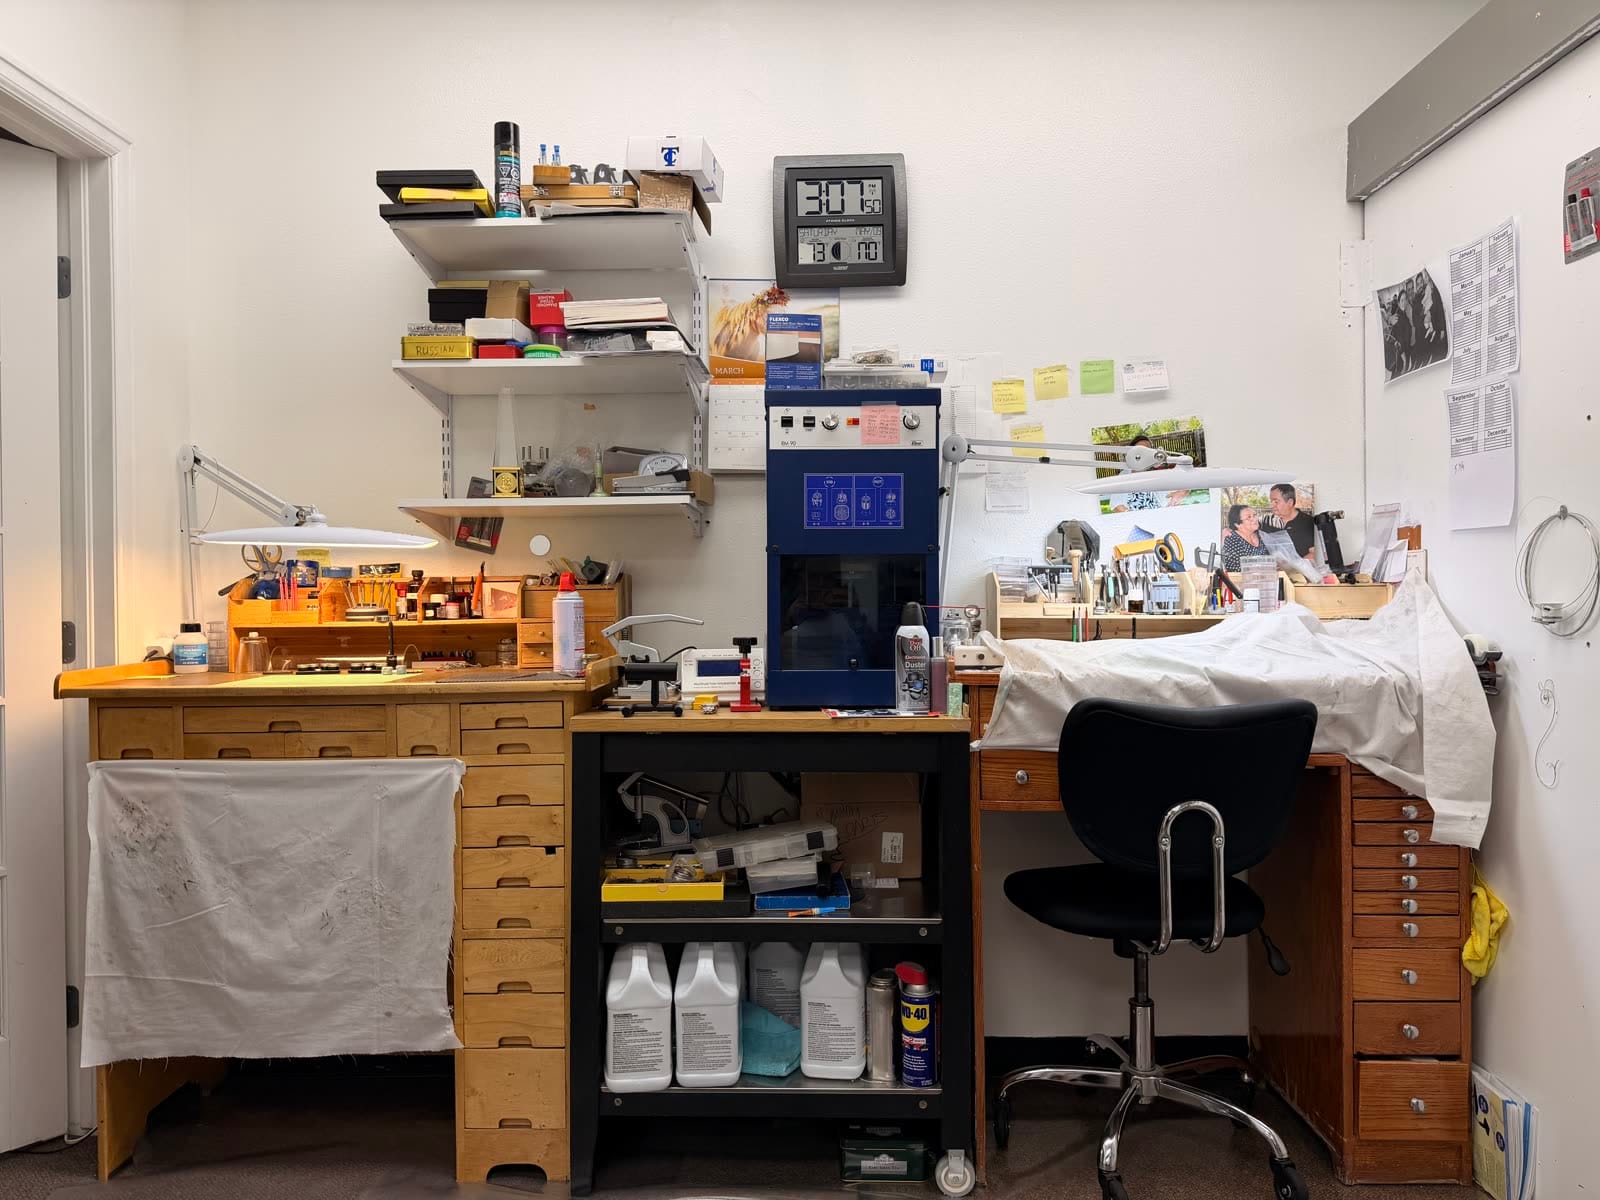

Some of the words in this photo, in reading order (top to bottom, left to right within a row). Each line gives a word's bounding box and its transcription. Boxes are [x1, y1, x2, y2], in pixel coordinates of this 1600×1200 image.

[805, 180, 865, 216] 3:07
[864, 199, 881, 214] 50
[1492, 229, 1510, 242] February
[1457, 248, 1477, 260] January
[1496, 264, 1507, 274] April
[1460, 280, 1474, 290] March
[1495, 294, 1507, 303] June
[1463, 309, 1473, 317] May
[1494, 332, 1510, 343] August
[415, 344, 456, 357] RUSSIAN
[1462, 346, 1473, 354] July
[714, 367, 745, 375] MARCH
[1490, 383, 1507, 393] October
[1451, 392, 1477, 402] September
[1487, 428, 1509, 438] December
[905, 660, 926, 668] Duster
